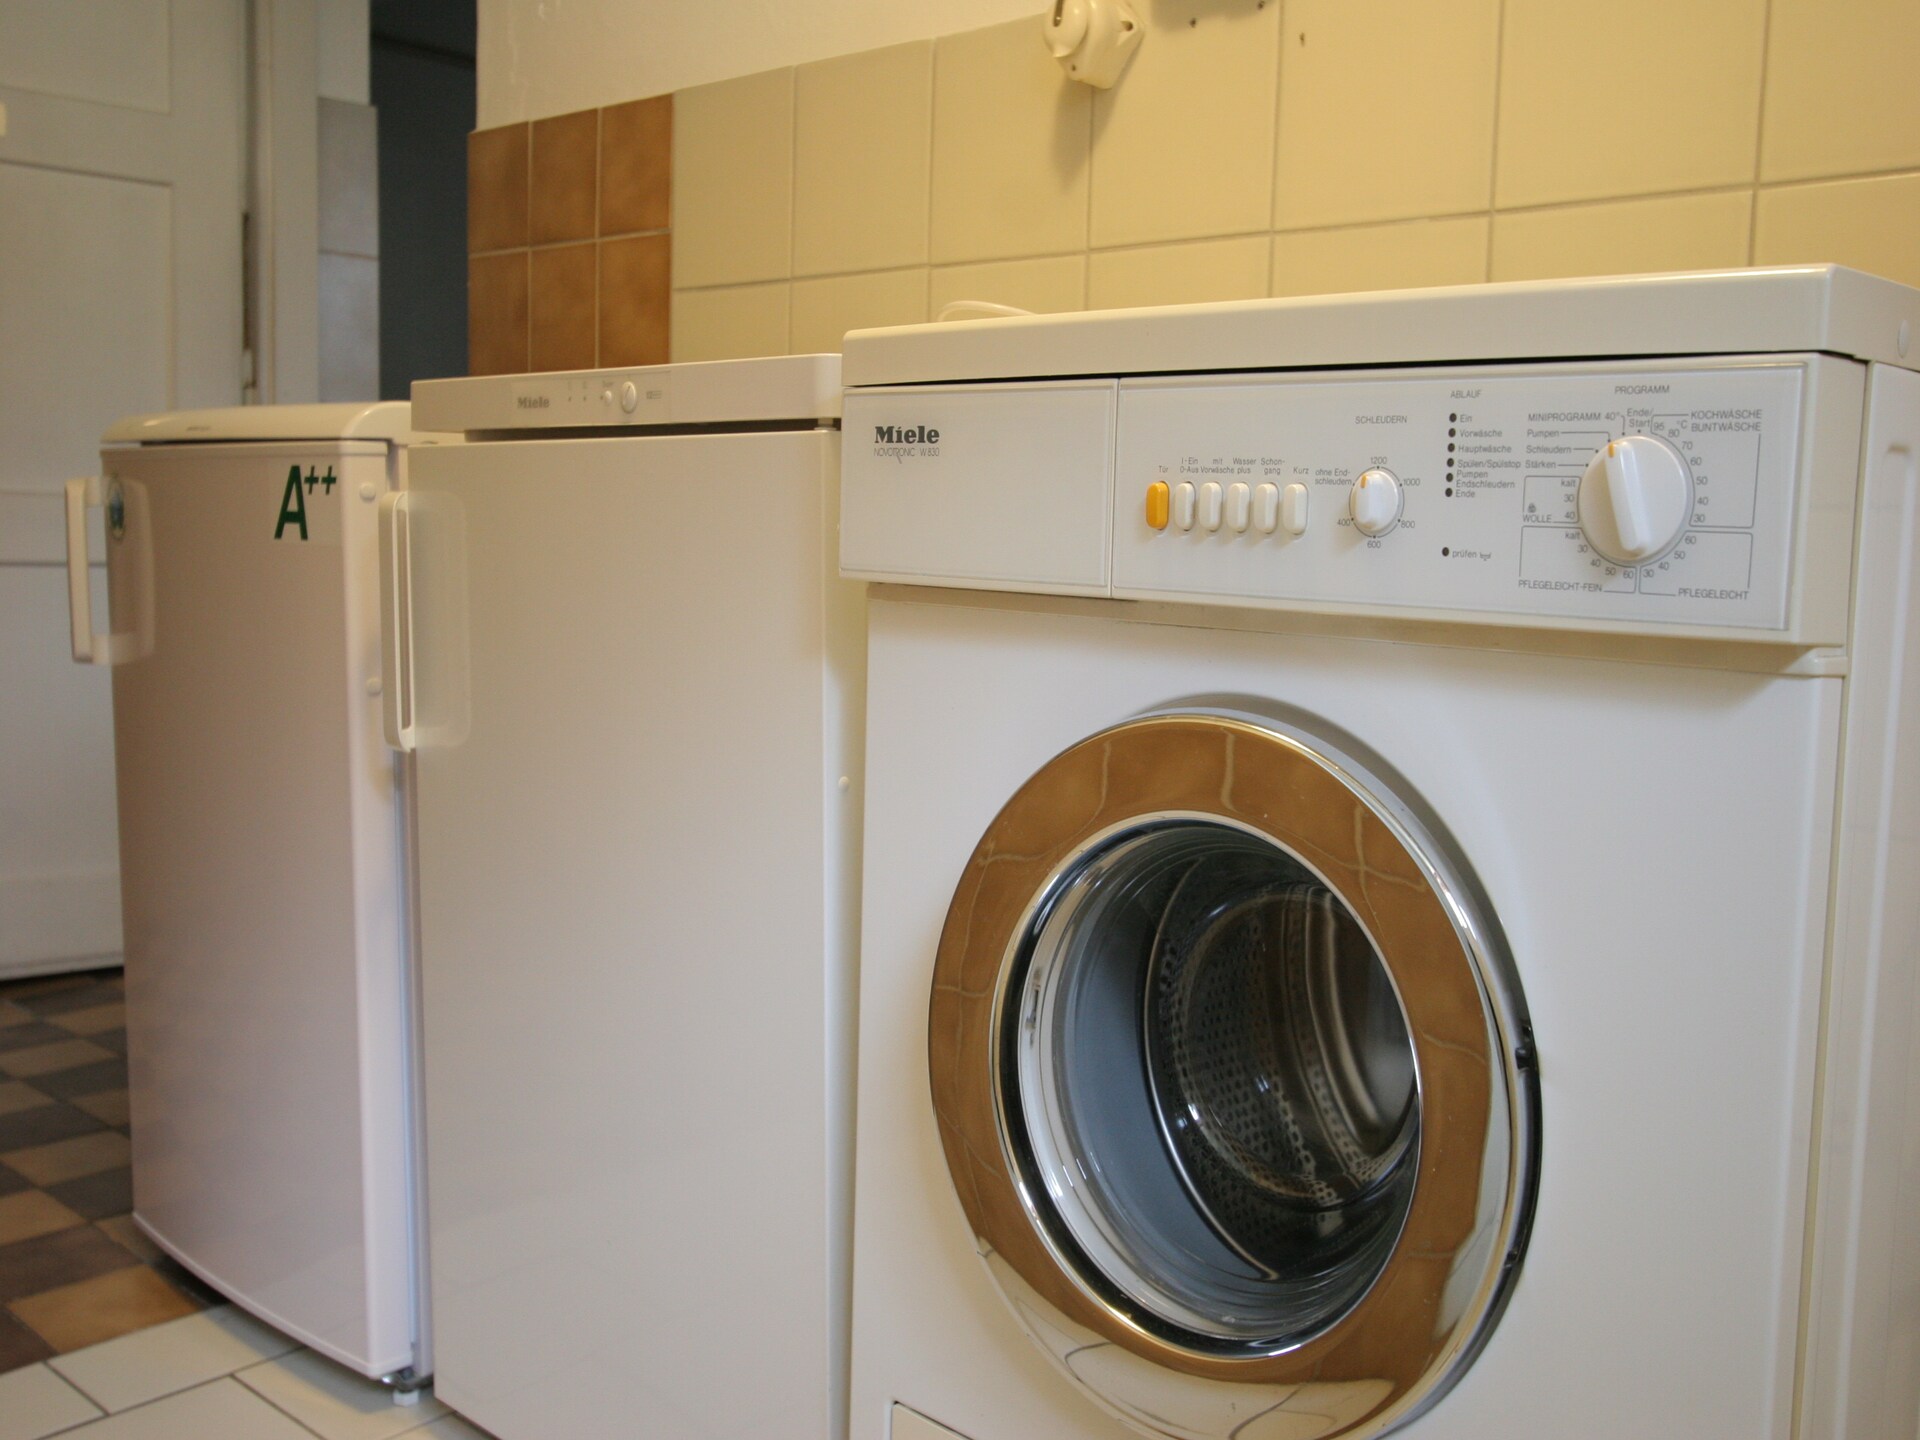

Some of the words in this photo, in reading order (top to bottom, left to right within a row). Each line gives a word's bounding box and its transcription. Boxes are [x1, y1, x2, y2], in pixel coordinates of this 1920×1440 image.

[1450, 390, 1482, 398] ABLAUF
[1615, 385, 1670, 394] PROGRAMM
[517, 396, 550, 408] Miele
[1460, 413, 1472, 422] Ein
[1528, 412, 1601, 421] MINIPROGRAMM
[1691, 409, 1762, 419] KOCHWÄSCHE
[1355, 415, 1407, 424] SCHLEUDERN
[1629, 418, 1650, 428] Start
[1691, 422, 1761, 431] BUNTWÄSCHE
[875, 426, 940, 444] Miele
[1459, 429, 1502, 438] Vorwäsche
[1527, 429, 1560, 438] Pumpen
[1668, 428, 1679, 437] 80
[1458, 444, 1512, 454] Hauptwäsche
[1526, 445, 1571, 454] Schleudern
[1682, 441, 1693, 450] 70
[1213, 457, 1223, 465] mit
[1233, 457, 1256, 466] Wasser
[1261, 457, 1285, 466] Schon-
[1370, 456, 1387, 465] 1200
[1525, 460, 1556, 469] Stärken
[1691, 457, 1702, 466] 60
[1201, 466, 1234, 474] Vorwäsche
[1237, 466, 1251, 475] plus
[1264, 467, 1281, 476] gang
[1293, 466, 1309, 475] Kurz
[1315, 469, 1332, 477] ohne
[1456, 470, 1488, 479] Pumpen
[1403, 478, 1420, 486] 1000
[1561, 478, 1576, 487] kalt
[1696, 476, 1708, 485] 50
[1455, 489, 1475, 498] Ende
[1564, 494, 1574, 502] 30
[274, 465, 336, 540] A++
[1697, 496, 1709, 505] 40
[1523, 515, 1552, 523] WOLLE
[1564, 511, 1575, 520] 40
[1694, 514, 1705, 523] 30
[1337, 518, 1351, 527] 400
[1401, 520, 1415, 529] 800
[1565, 531, 1580, 540] kalt
[1685, 535, 1696, 544] 60
[1367, 540, 1381, 548] 600
[1577, 544, 1588, 553] 30
[1452, 550, 1477, 559] prüfen
[1674, 551, 1685, 559] 50
[1590, 559, 1601, 568] 40
[1658, 562, 1669, 570] 40
[1605, 567, 1616, 576] 50
[1623, 570, 1634, 579] 60
[1643, 569, 1654, 578] 30
[1518, 580, 1602, 592] PFLEGELEICHT-FEIN
[1678, 588, 1749, 600] PFLEGELEICHT
